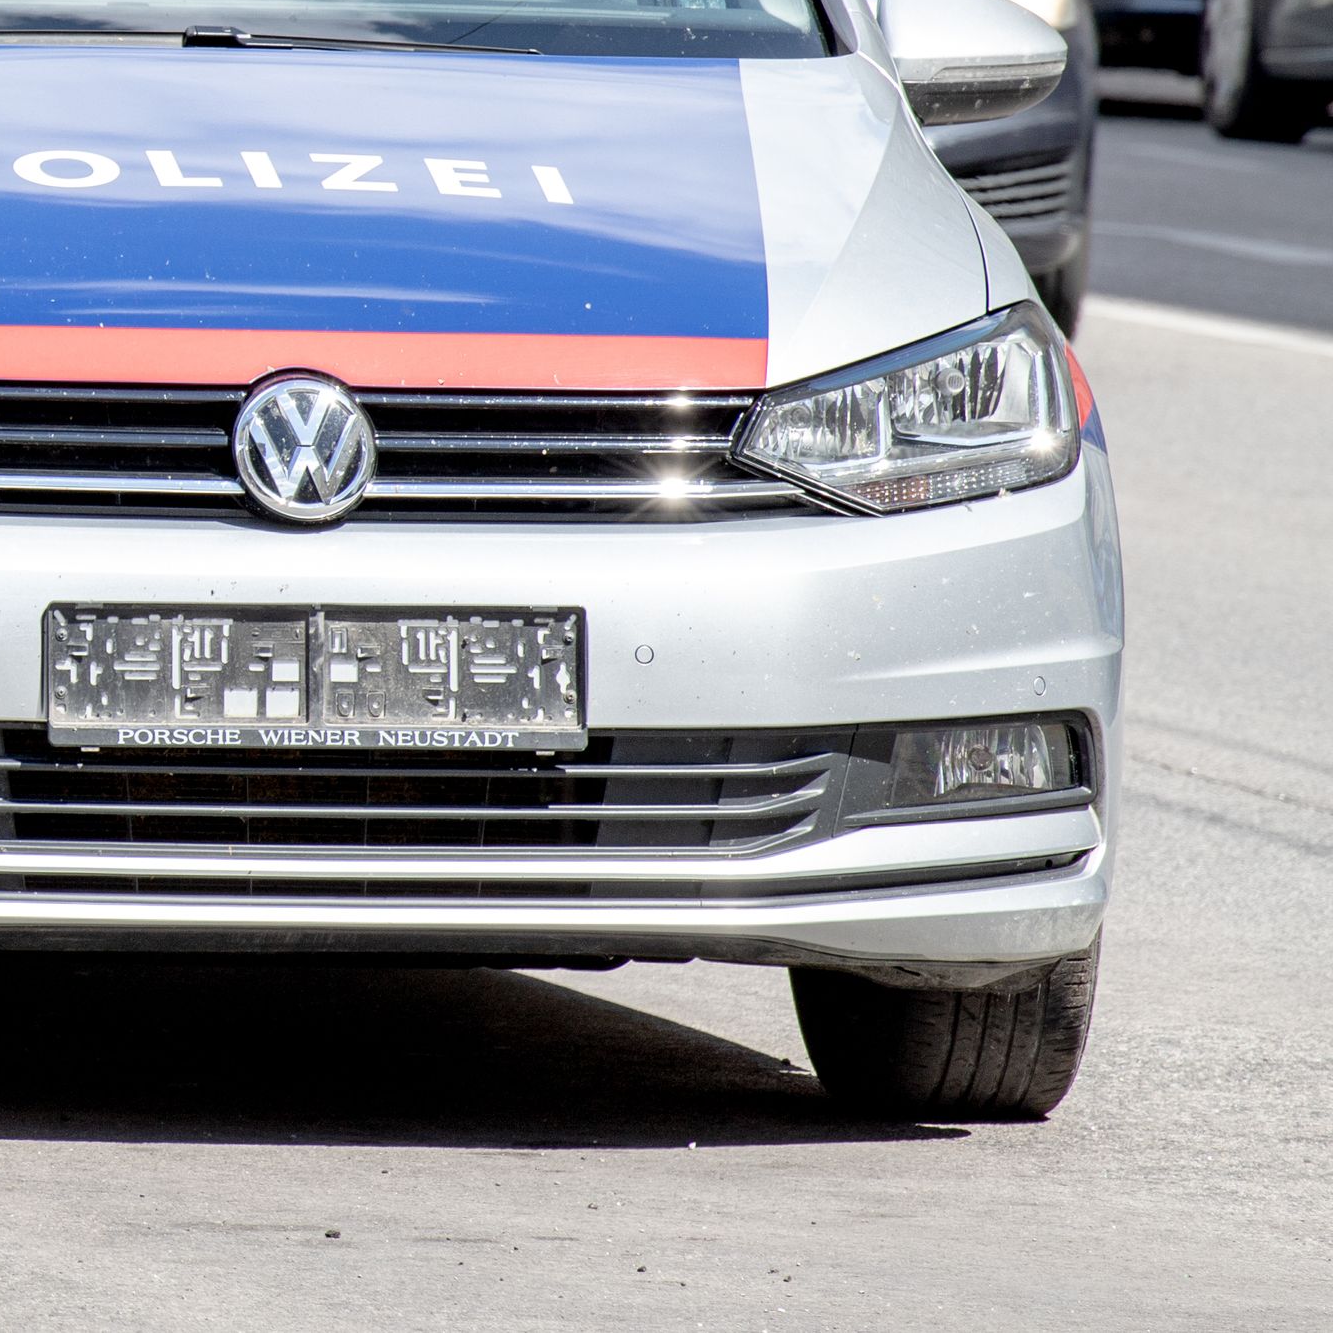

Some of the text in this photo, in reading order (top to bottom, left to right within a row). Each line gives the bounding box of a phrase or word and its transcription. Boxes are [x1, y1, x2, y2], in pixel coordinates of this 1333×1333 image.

[116, 727, 521, 749] PORSCHE WIENER NEUSTADT
